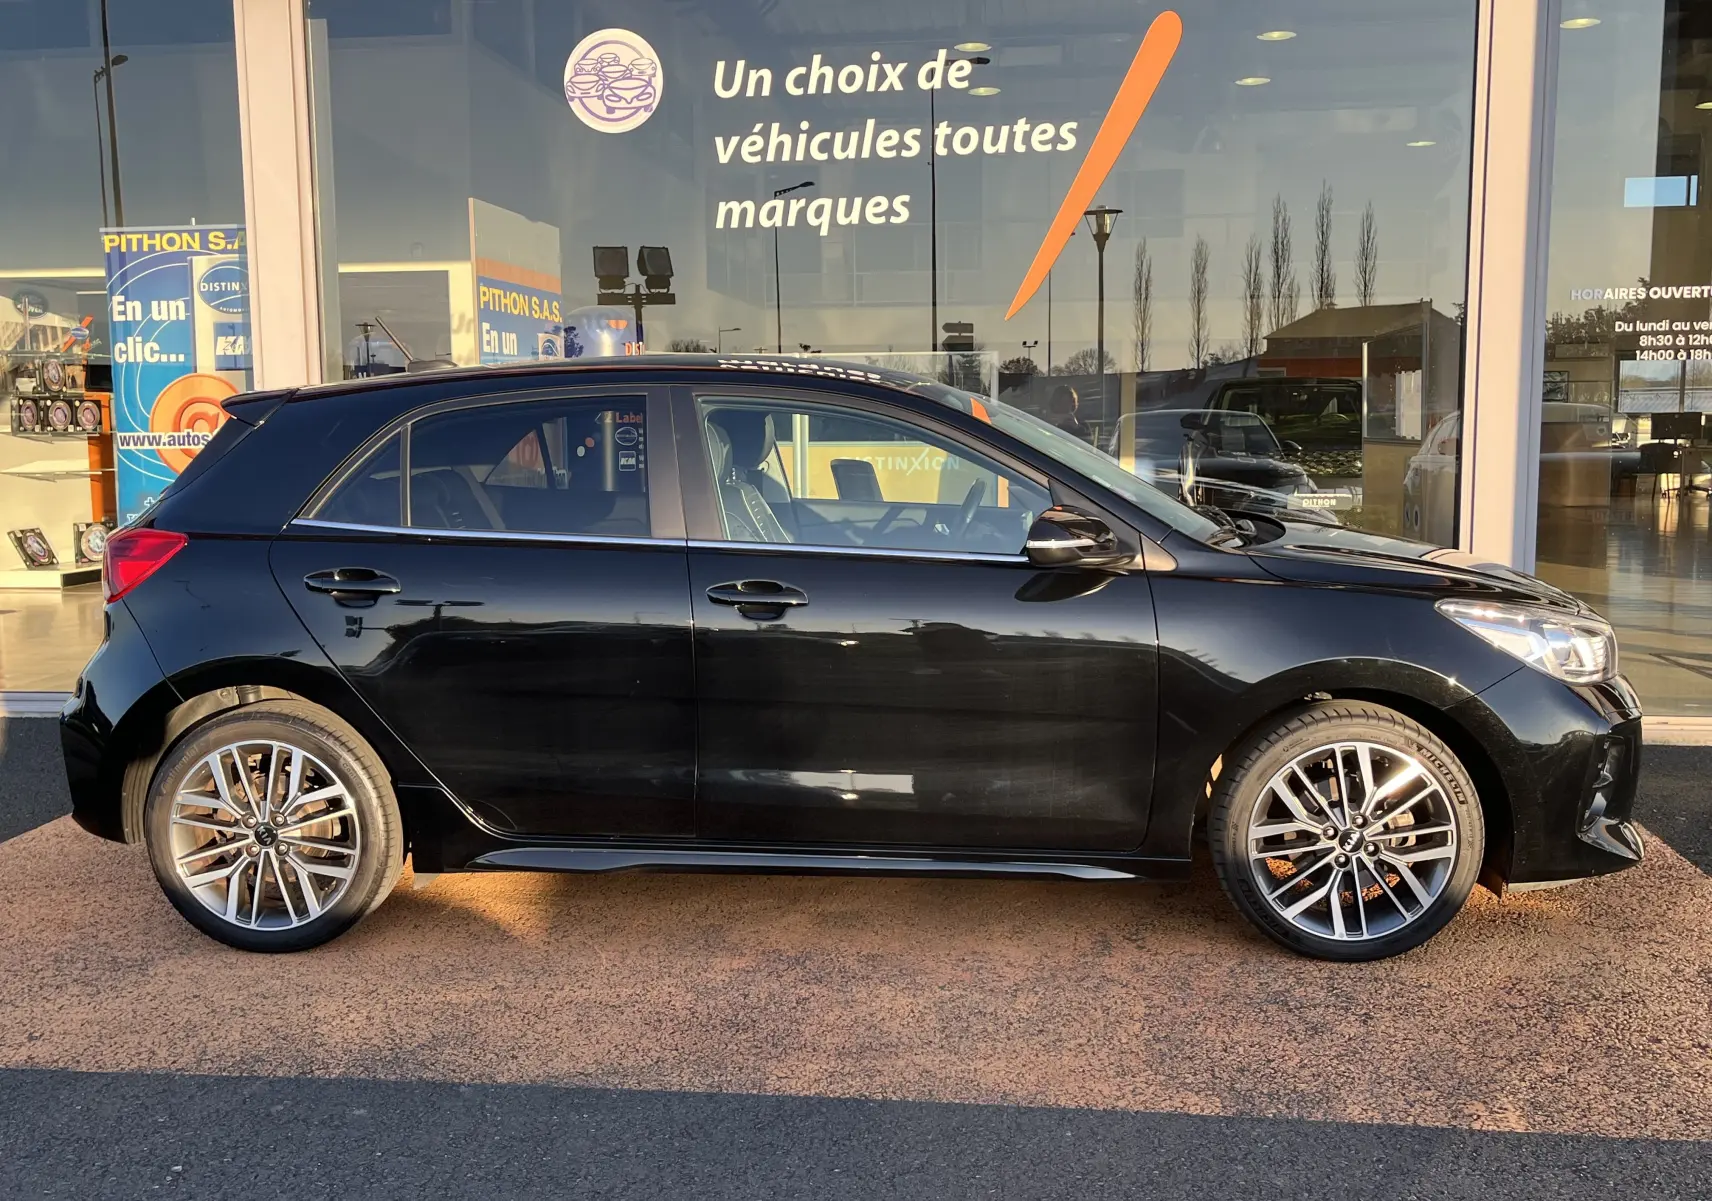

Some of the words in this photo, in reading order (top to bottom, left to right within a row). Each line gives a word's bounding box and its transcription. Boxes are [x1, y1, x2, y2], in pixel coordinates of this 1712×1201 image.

[714, 59, 773, 99] Un
[785, 51, 908, 96] choix
[917, 48, 973, 91] de
[714, 118, 921, 165] véhicules
[934, 117, 1078, 157] toutes
[715, 192, 911, 237] marques
[103, 232, 201, 253] PITHON
[480, 284, 530, 317] PITHON
[531, 296, 563, 323] S.A.S.
[1570, 286, 1646, 300] HORAIRES
[1649, 285, 1712, 300] OUVERT
[112, 295, 142, 322] En
[150, 300, 186, 321] un
[481, 321, 499, 354] En
[502, 331, 518, 356] un
[1615, 321, 1634, 333] Du
[1636, 319, 1669, 332] lundi
[1672, 321, 1690, 331] au
[114, 336, 185, 364] clic...
[1639, 334, 1673, 347] 8h30
[1675, 334, 1686, 346] à
[1635, 349, 1674, 361] 14h00
[1677, 349, 1687, 361] à
[1418, 745, 1468, 805] MICHELIN
